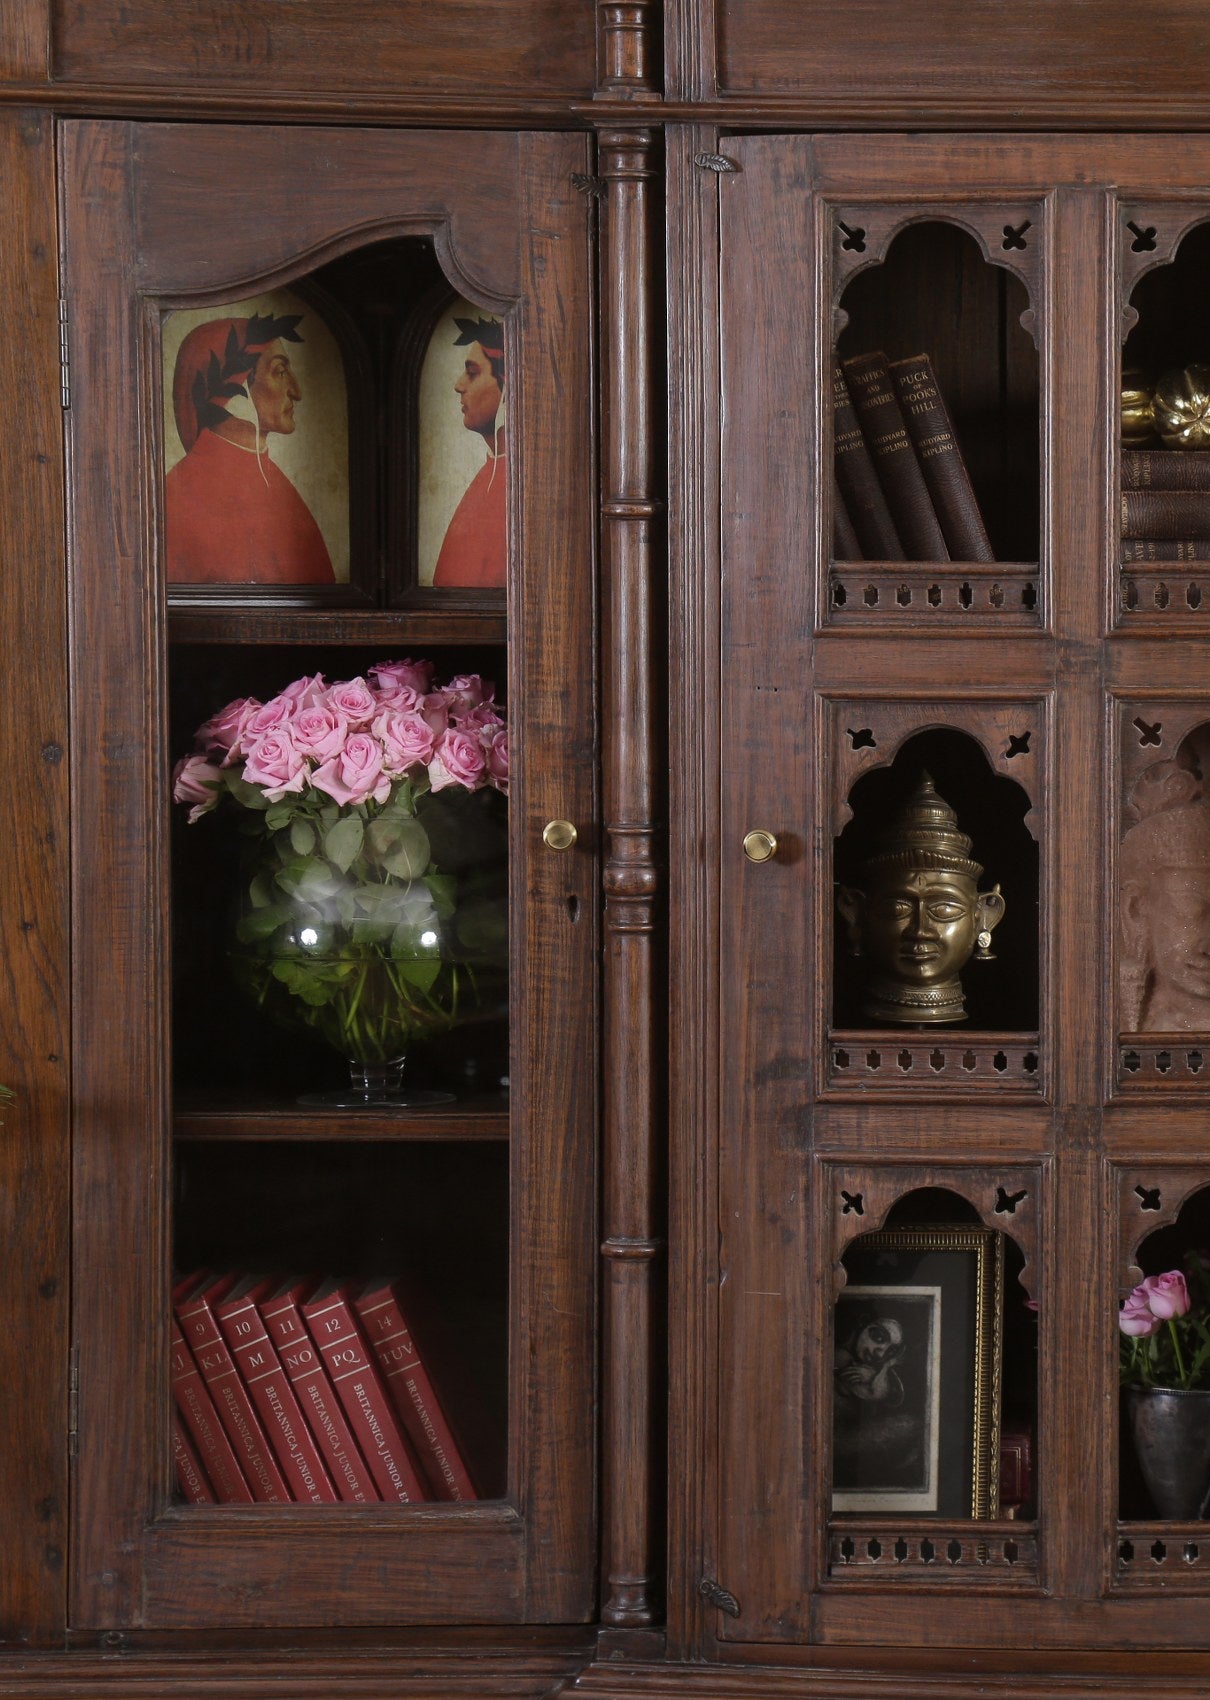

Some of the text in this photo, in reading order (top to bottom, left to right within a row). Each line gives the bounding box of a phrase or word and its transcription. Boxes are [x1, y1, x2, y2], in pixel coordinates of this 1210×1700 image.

[901, 370, 929, 386] PUCK
[911, 401, 937, 415] HILL
[921, 443, 954, 458] KIPLING
[196, 1323, 206, 1336] 9
[235, 1321, 251, 1336] 10
[279, 1320, 295, 1335] 11
[324, 1318, 341, 1333] 12
[378, 1315, 392, 1331] 14
[247, 1352, 265, 1368] M
[286, 1349, 312, 1369] NO
[332, 1349, 361, 1367] PQ
[381, 1342, 413, 1365] TUV
[222, 1387, 255, 1452] BRITANNICA
[248, 1452, 274, 1493] JUNIOR
[265, 1385, 299, 1451] BRITANNICA
[291, 1452, 315, 1493] JUNIOR
[307, 1385, 341, 1451] BRITANNICA
[333, 1451, 360, 1490] JUNIOR
[353, 1383, 387, 1449] BRITANNICA
[378, 1449, 403, 1489] JUNIOR
[405, 1378, 438, 1444] BRITANNICA
[431, 1446, 456, 1485] JUNIOR
[176, 1453, 201, 1495] JUNIOR
